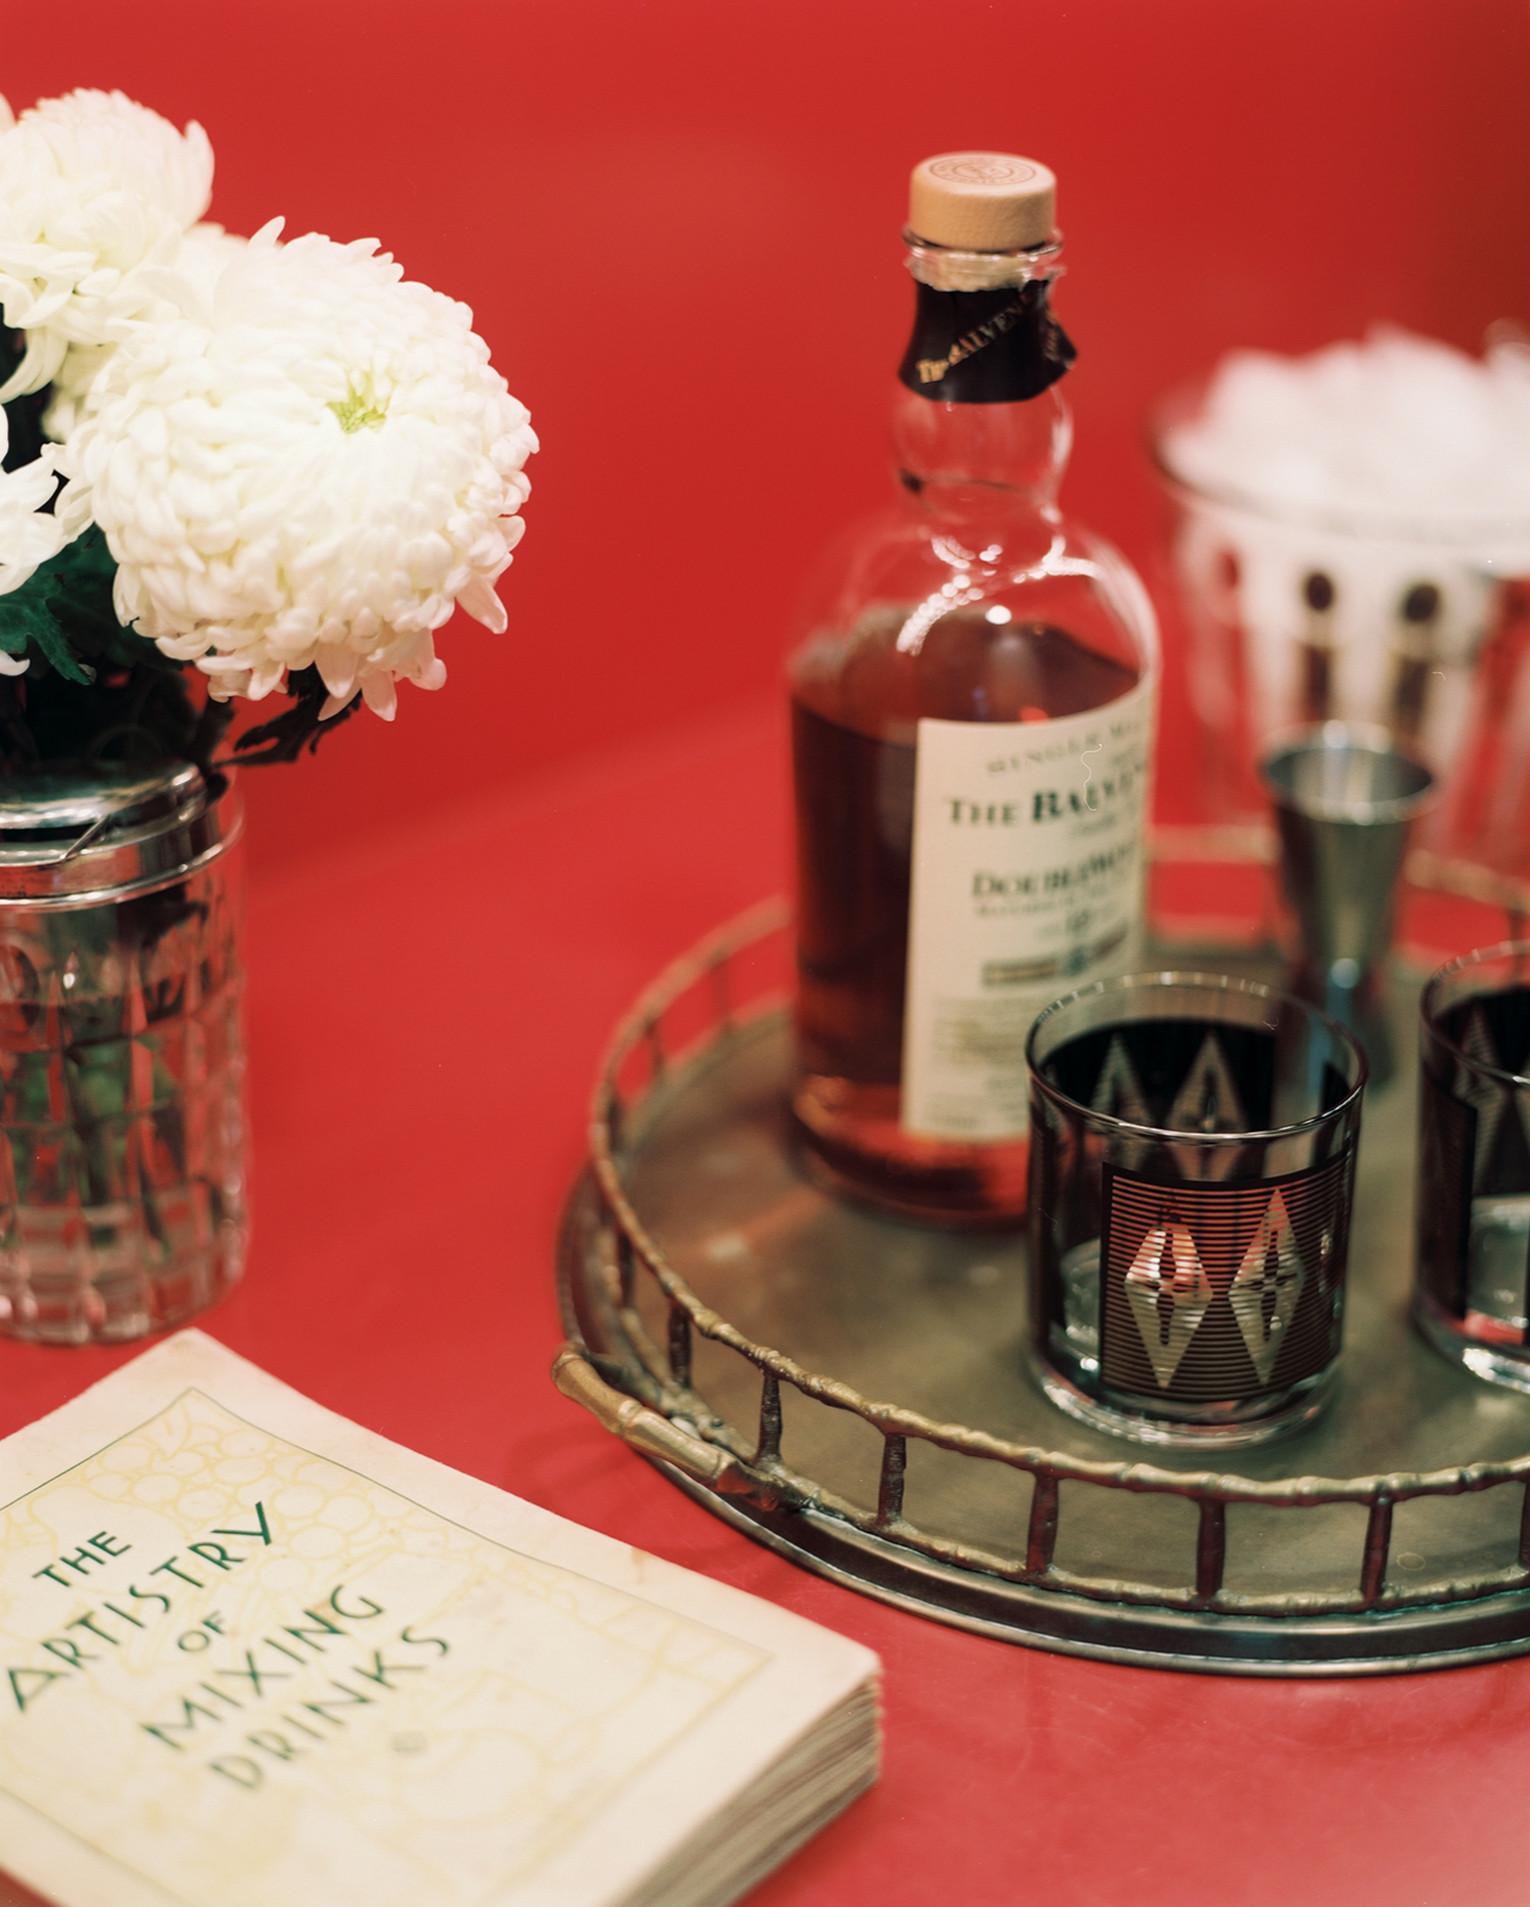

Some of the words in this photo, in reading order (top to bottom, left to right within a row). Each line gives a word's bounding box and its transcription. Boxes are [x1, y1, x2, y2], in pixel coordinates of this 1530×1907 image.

[7, 1501, 273, 1714] ARTISTRY
[31, 1530, 133, 1588] THE
[176, 1610, 227, 1653] OF
[140, 1584, 386, 1752] MIXING
[208, 1625, 450, 1791] DRINKS
